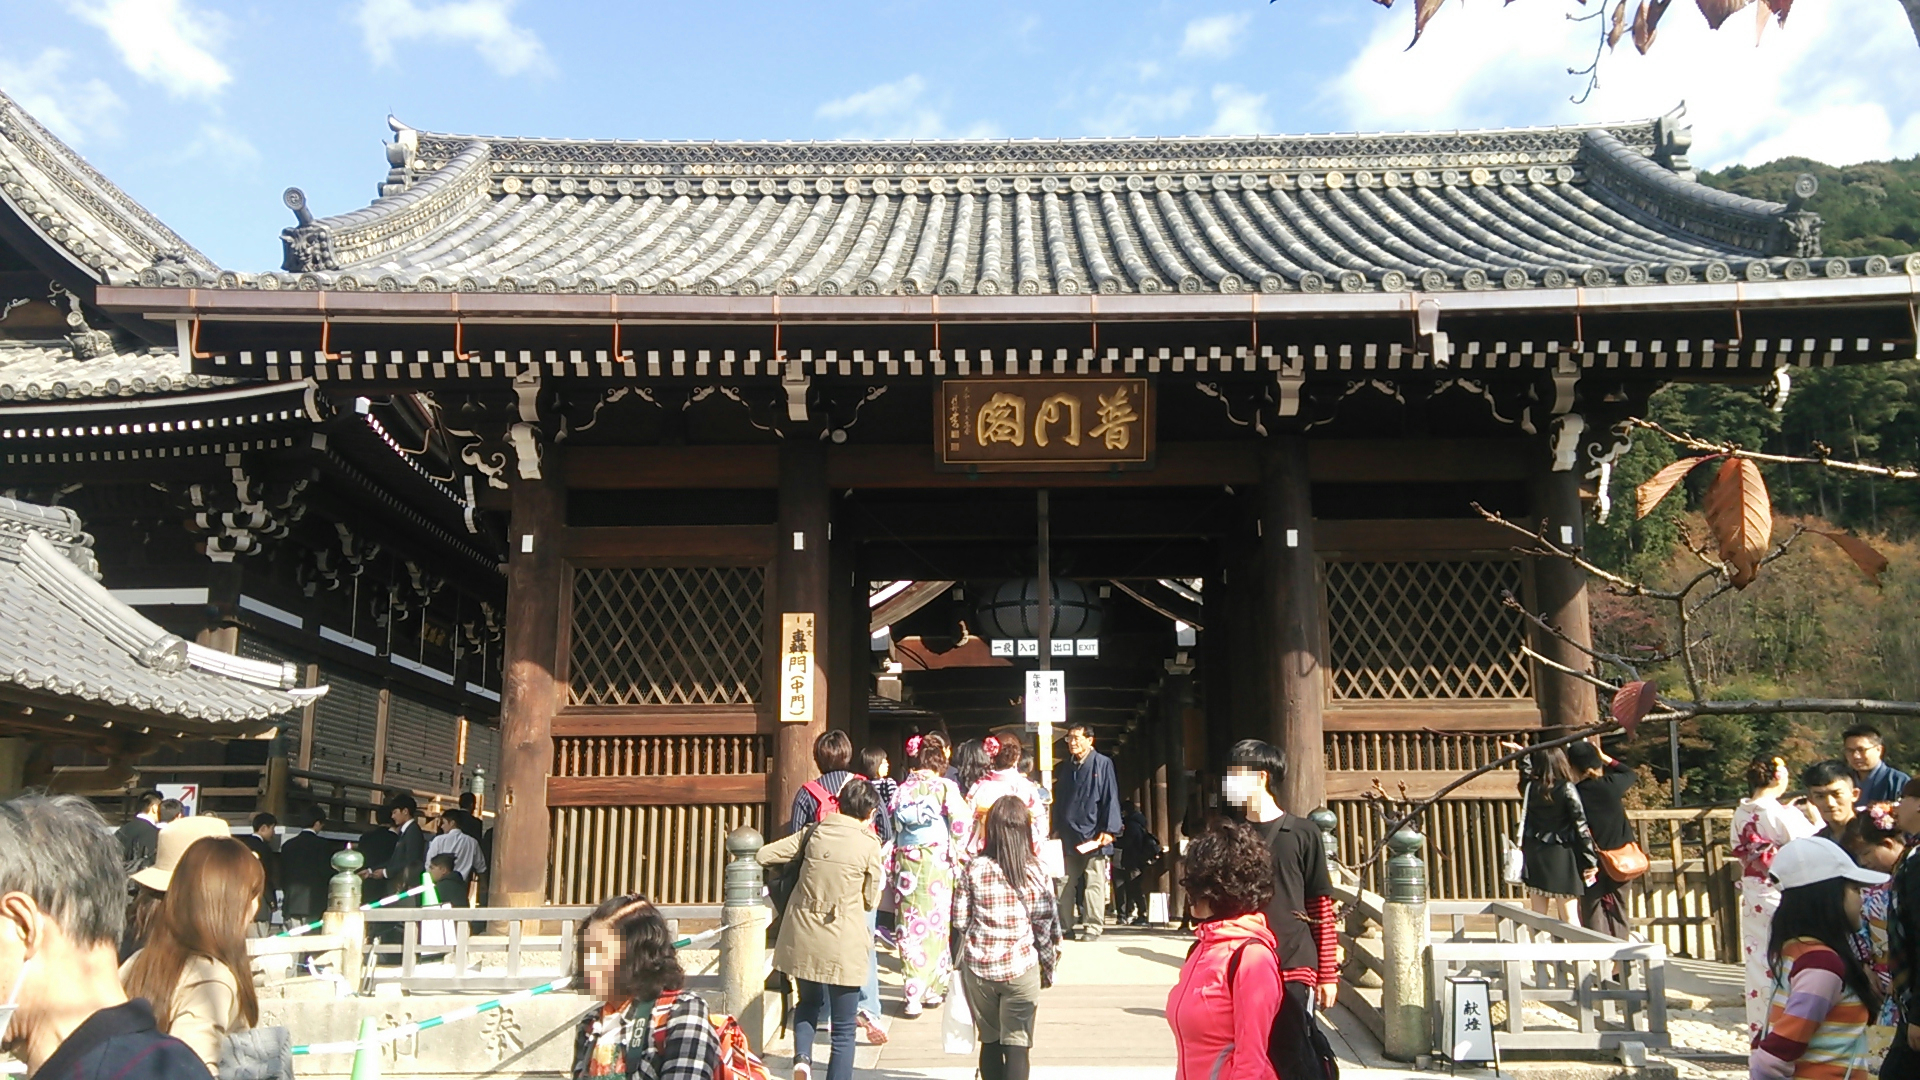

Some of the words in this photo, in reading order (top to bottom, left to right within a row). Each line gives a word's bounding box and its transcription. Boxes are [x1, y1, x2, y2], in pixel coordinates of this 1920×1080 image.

[977, 385, 1138, 450] 普門閣
[1019, 643, 1036, 652] 入口
[1053, 643, 1071, 652] 出口
[1078, 643, 1096, 651] EXIT
[631, 1018, 646, 1048] EOS
